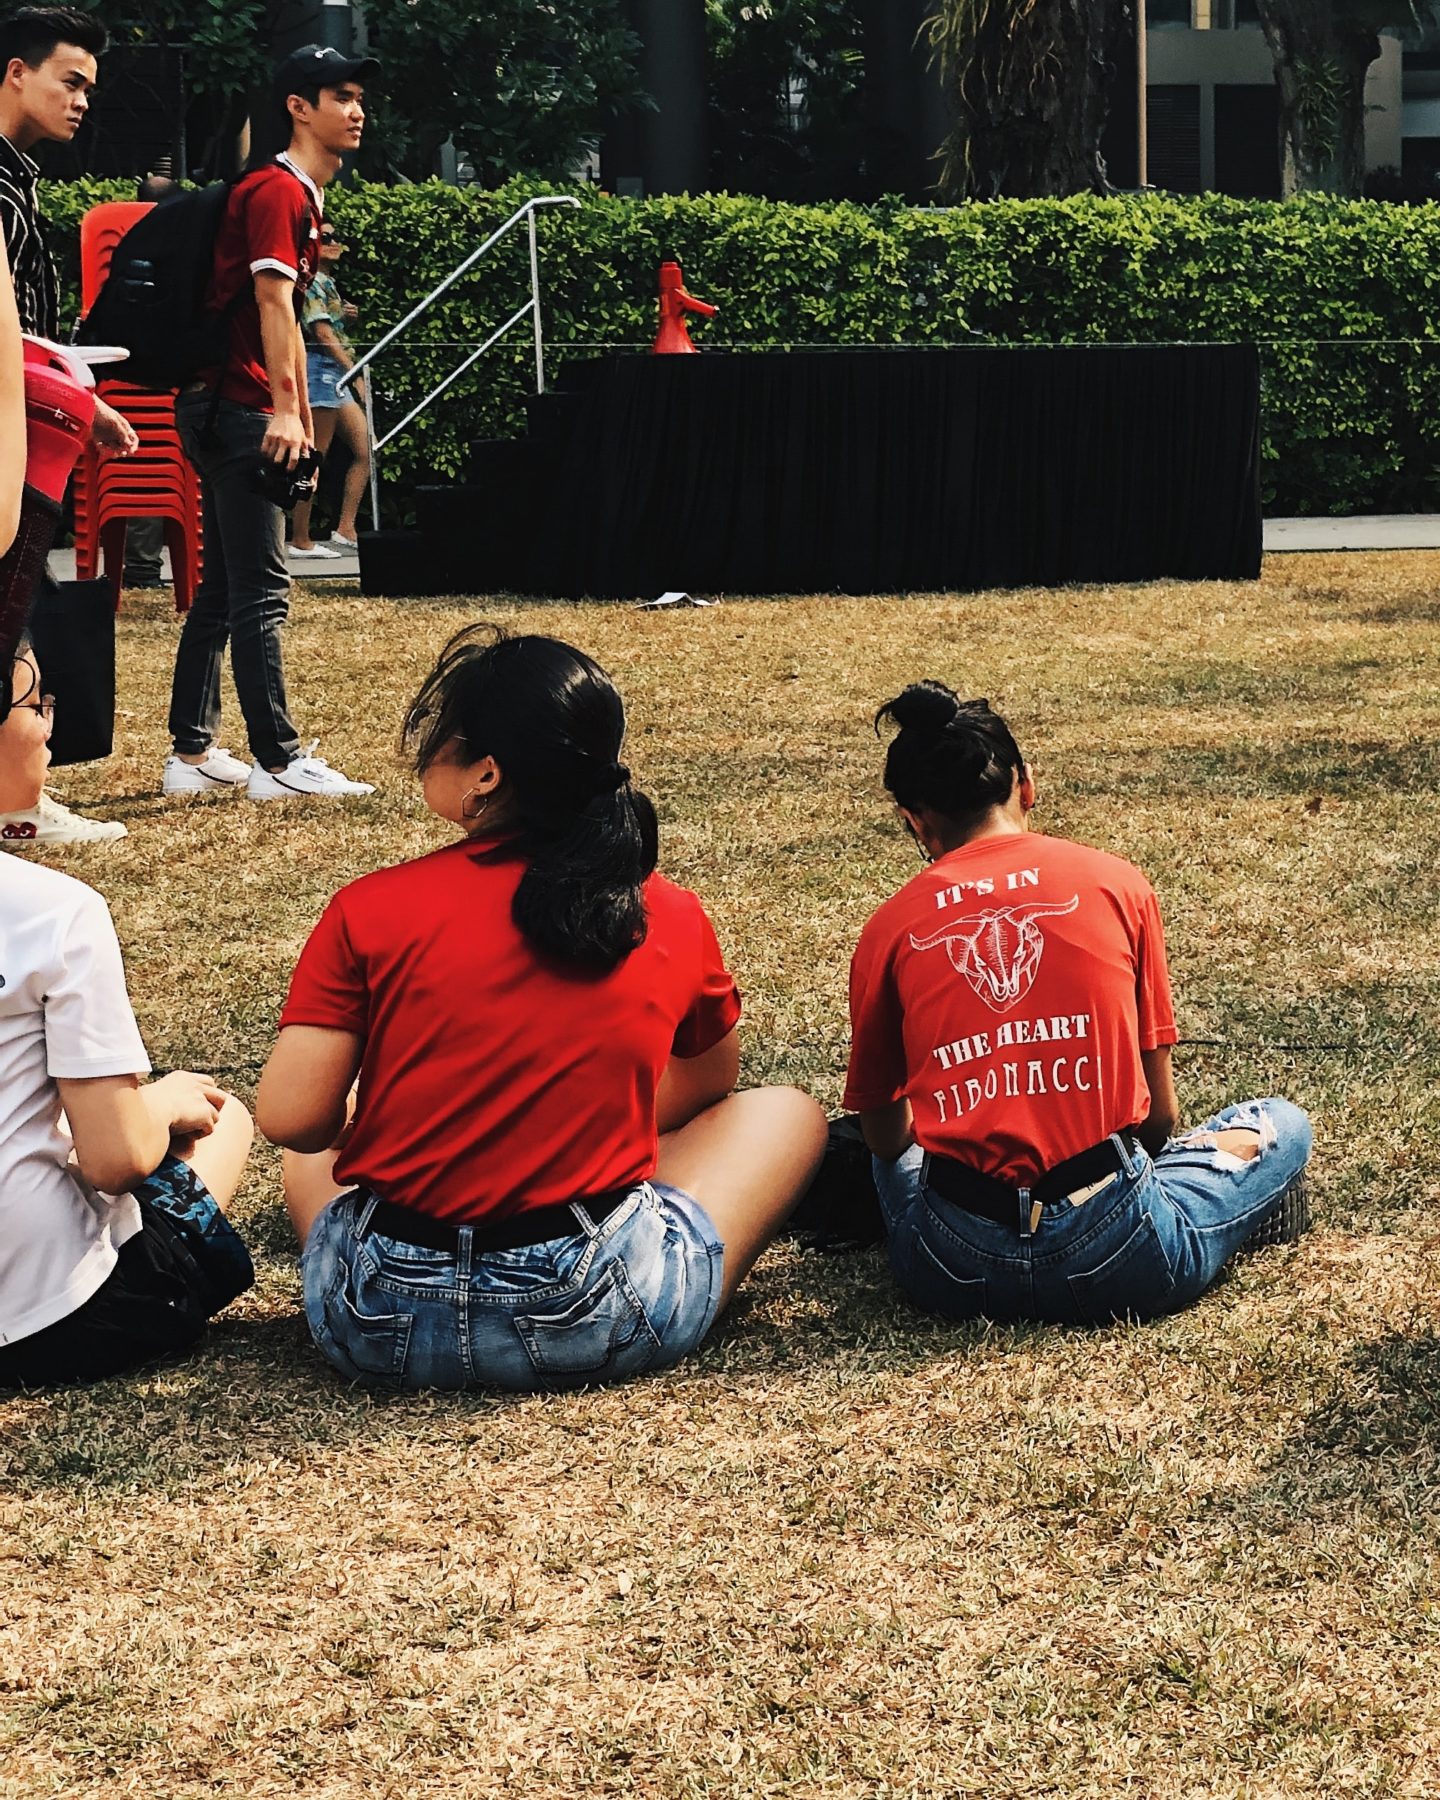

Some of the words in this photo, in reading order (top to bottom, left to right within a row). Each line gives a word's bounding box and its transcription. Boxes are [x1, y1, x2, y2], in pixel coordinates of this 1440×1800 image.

[935, 877, 995, 910] IT'S
[1005, 867, 1041, 890] IN
[932, 1031, 992, 1070] THE
[996, 1014, 1090, 1048] HEART
[933, 1055, 1103, 1123] FIBONACCI
